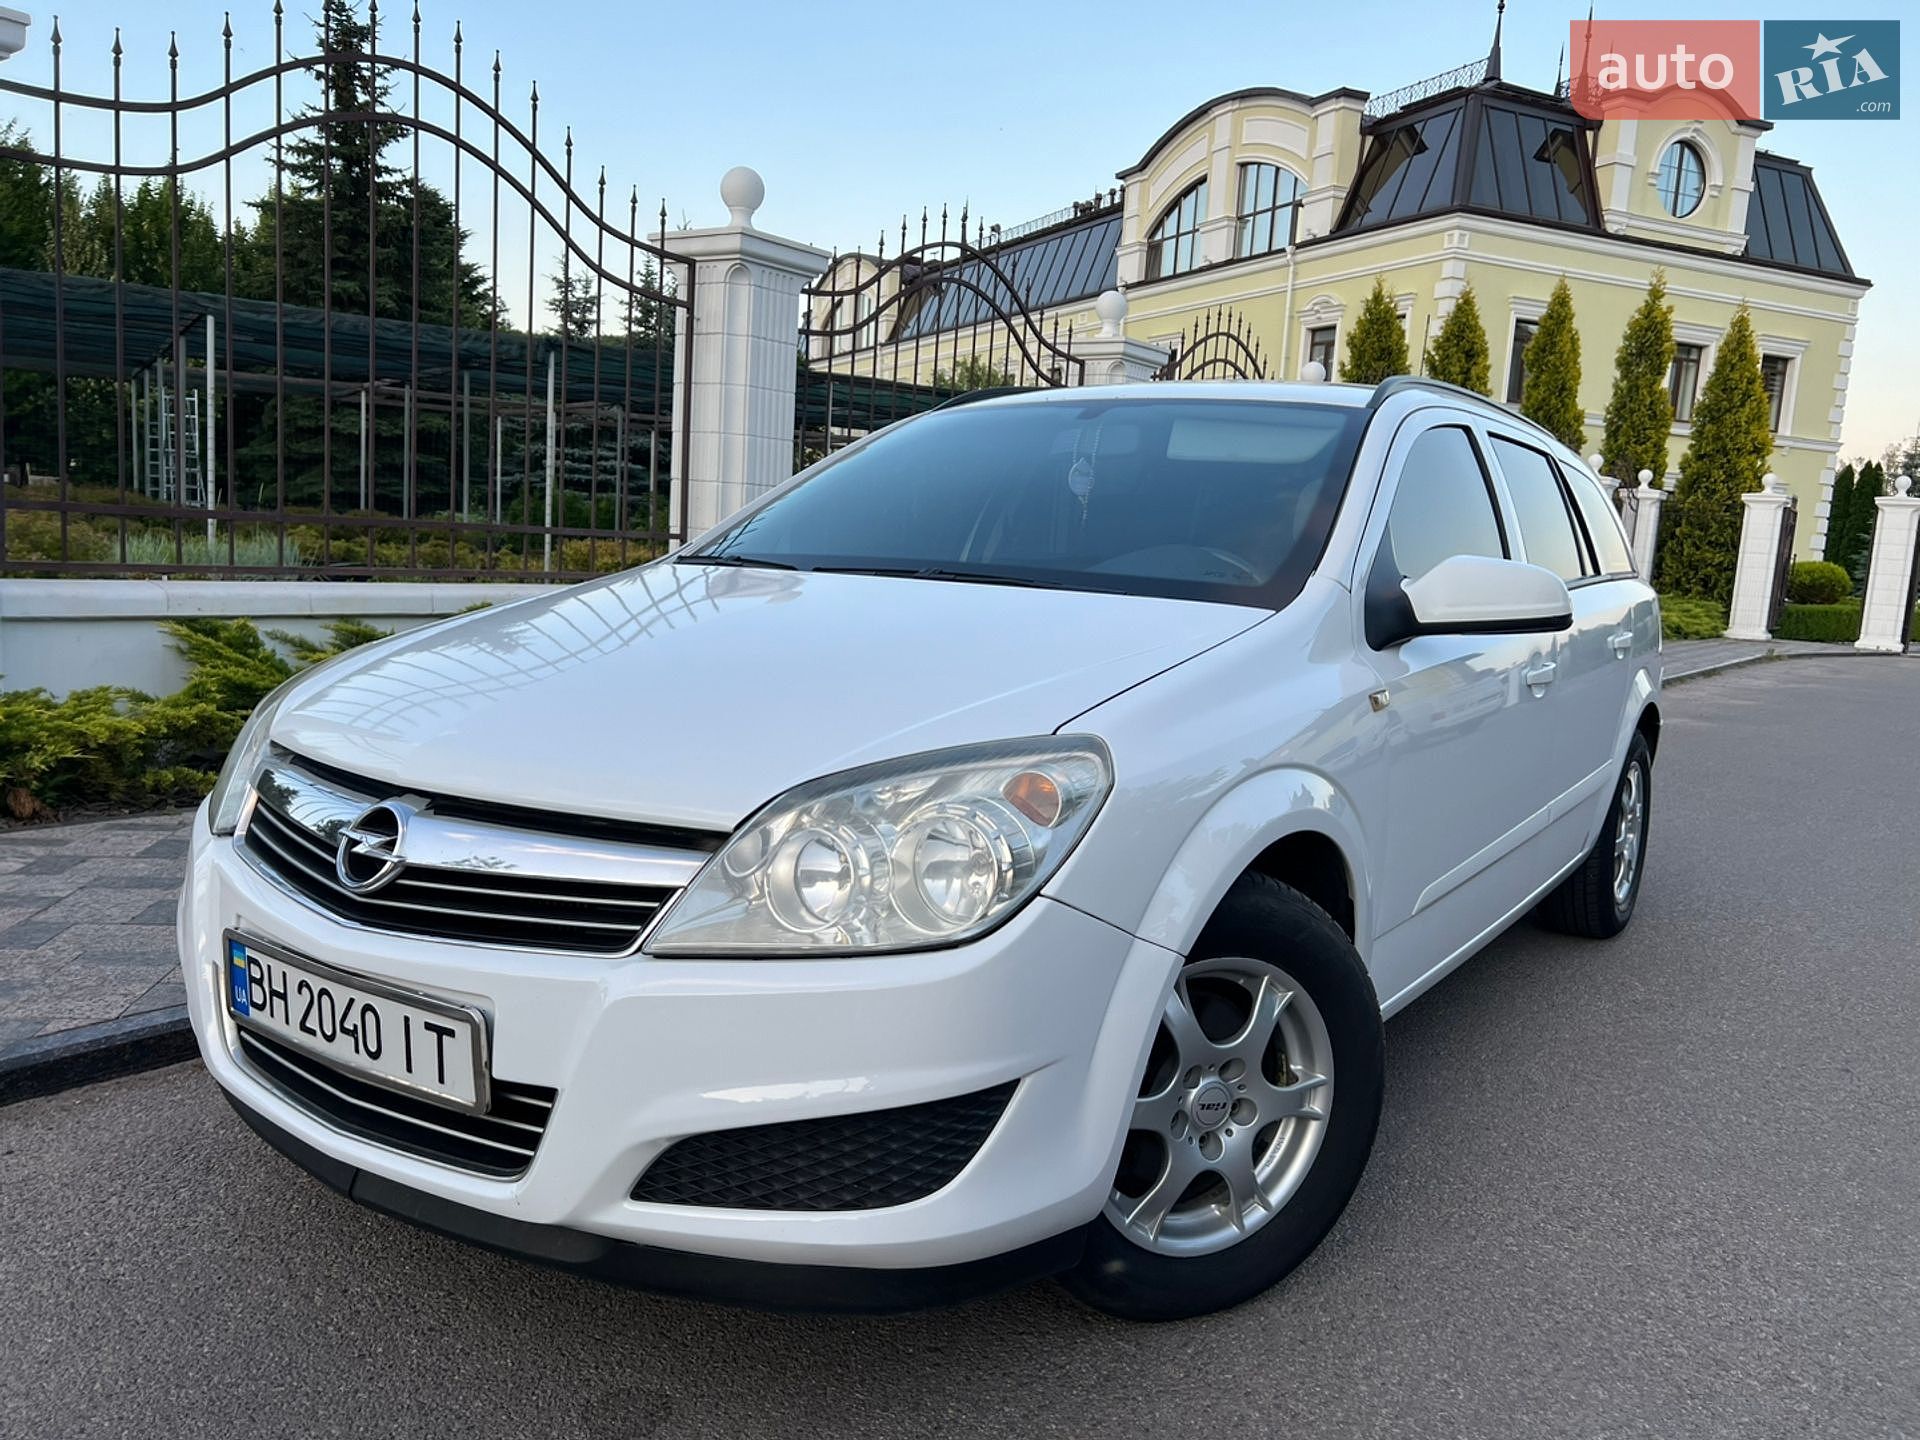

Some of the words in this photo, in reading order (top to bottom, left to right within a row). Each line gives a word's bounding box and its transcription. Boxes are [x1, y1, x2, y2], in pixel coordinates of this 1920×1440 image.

[235, 985, 248, 1006] UA
[247, 955, 290, 1025] BH
[298, 980, 383, 1060] 2040
[404, 1015, 456, 1084] IT
